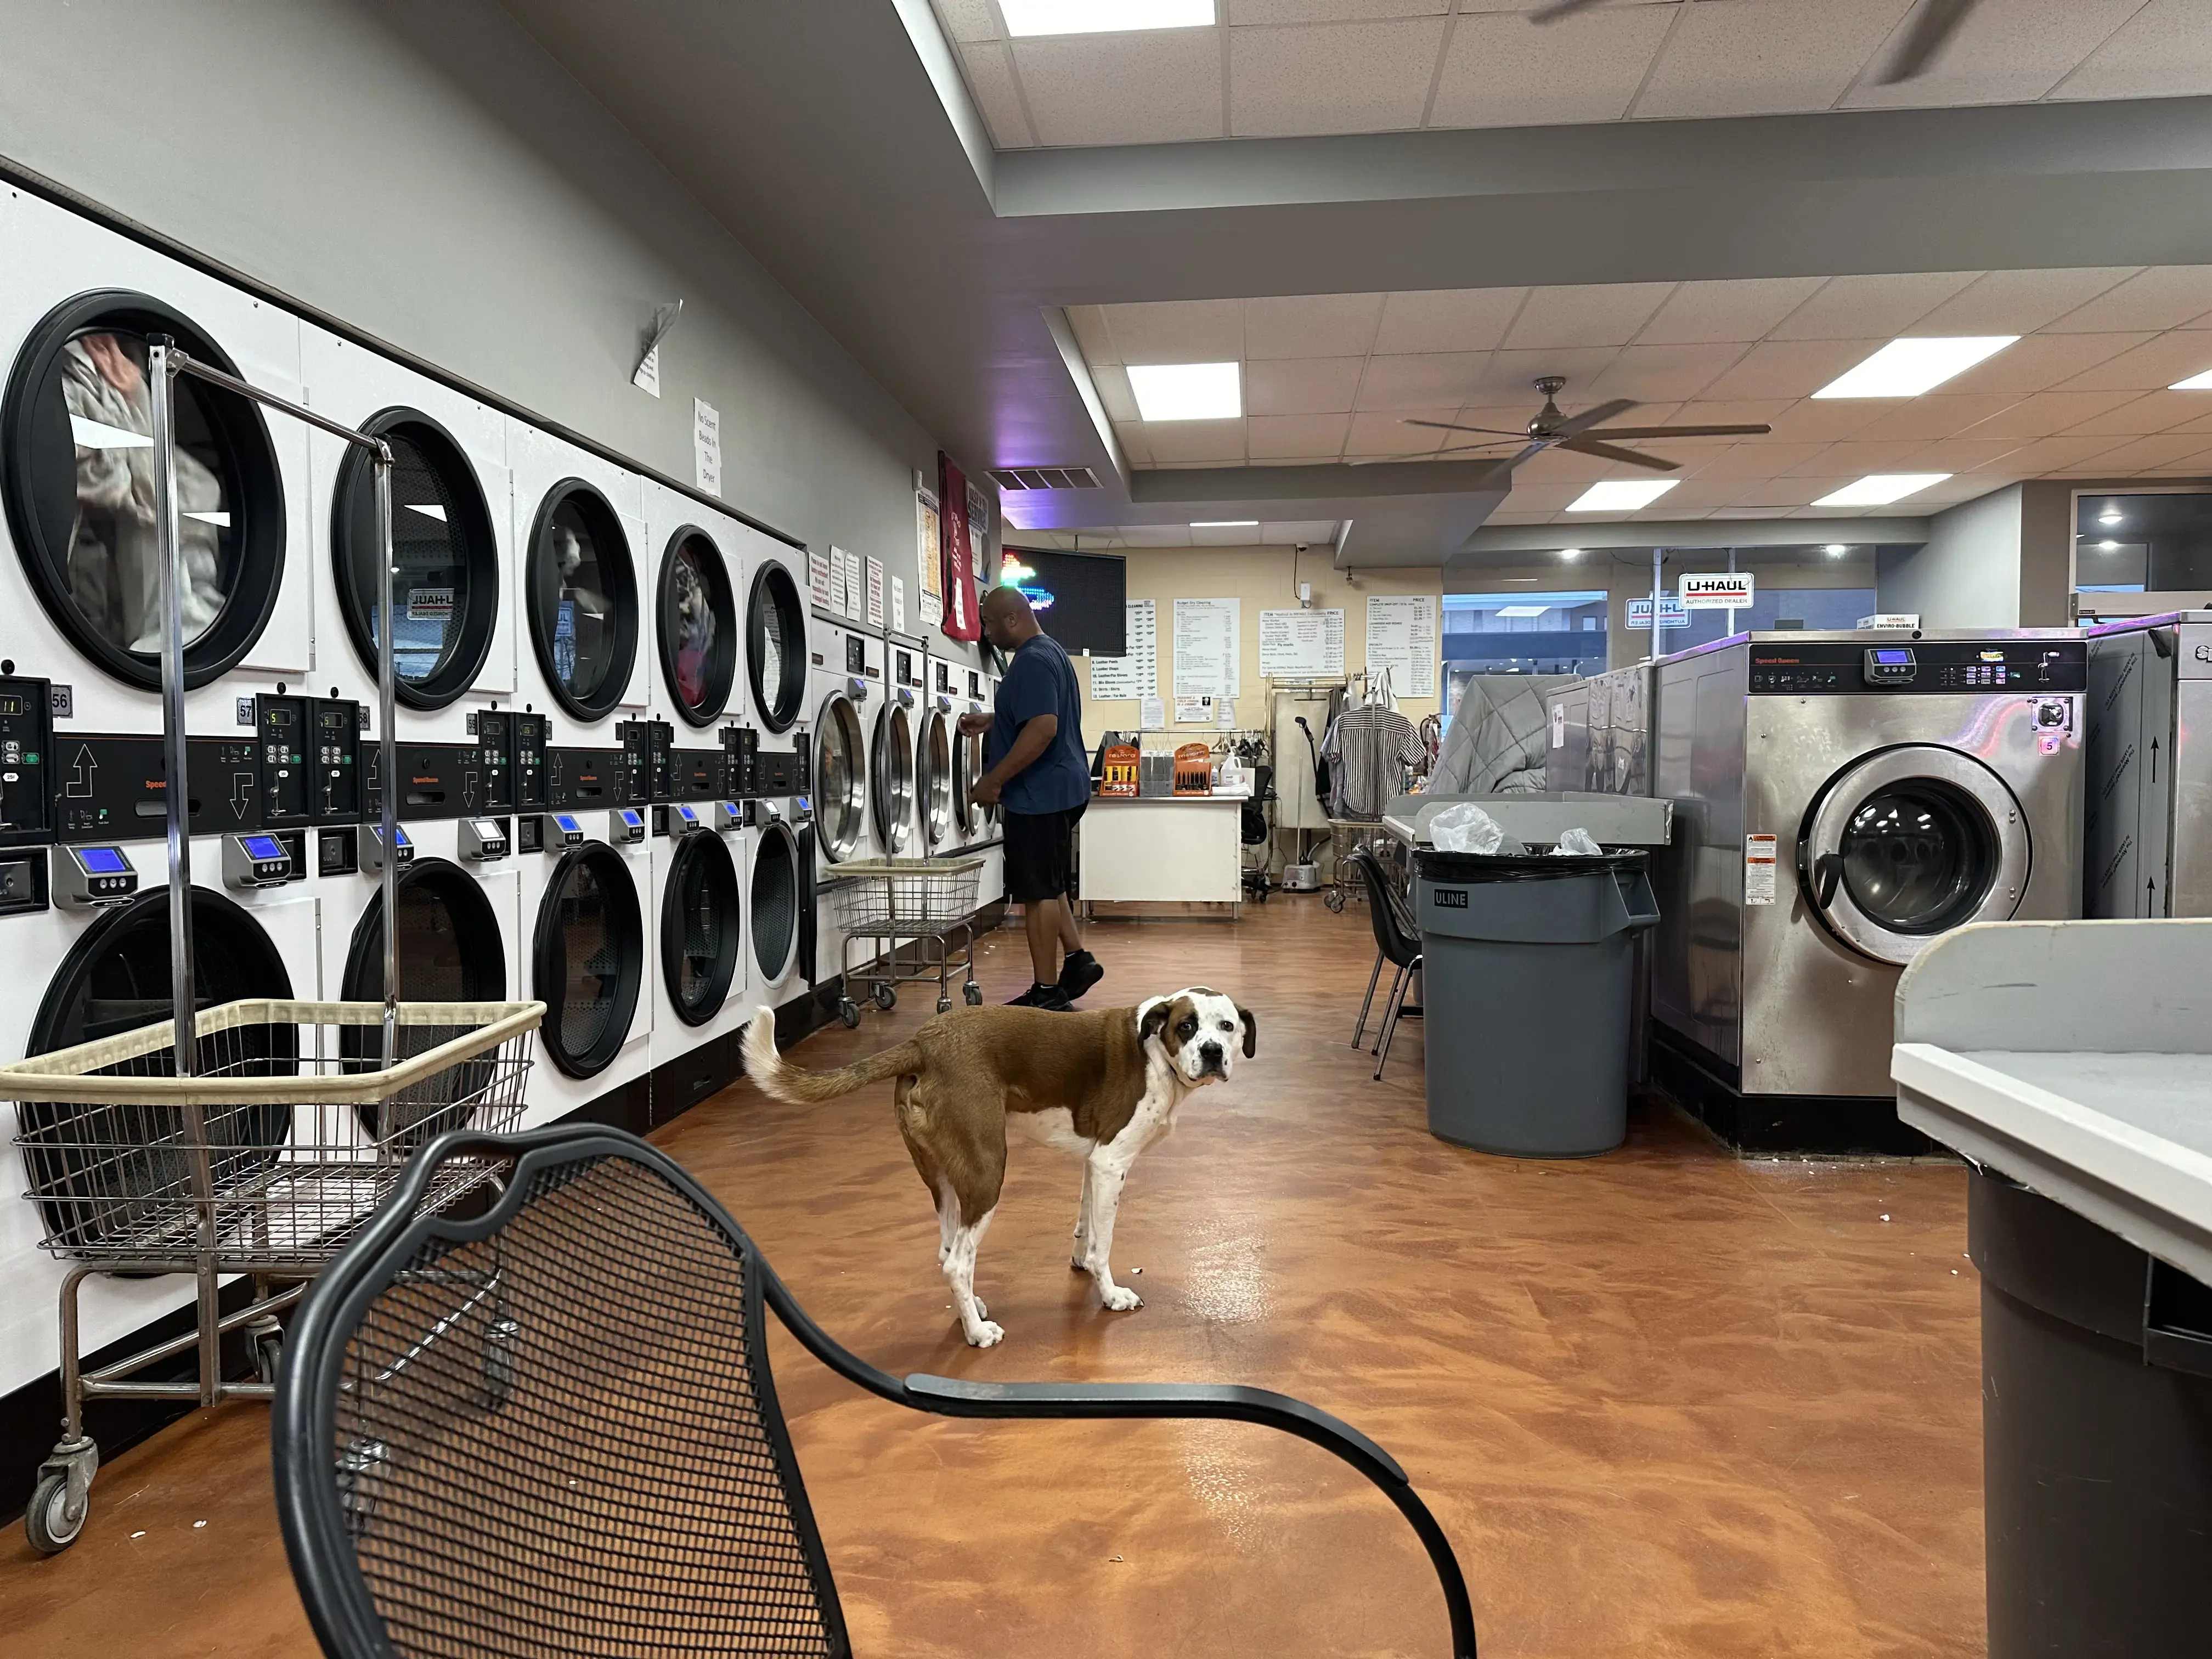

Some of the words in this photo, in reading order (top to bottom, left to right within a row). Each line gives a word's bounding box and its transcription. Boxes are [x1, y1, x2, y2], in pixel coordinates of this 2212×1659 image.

[698, 411, 703, 424] No
[704, 415, 715, 431] Scent
[699, 430, 711, 446] Beads
[703, 469, 715, 483] Dryer
[1688, 581, 1746, 591] U-HAUL
[52, 694, 67, 708] 56
[240, 706, 251, 717] 57
[468, 720, 475, 729] 59
[1436, 891, 1466, 905] ULINE
